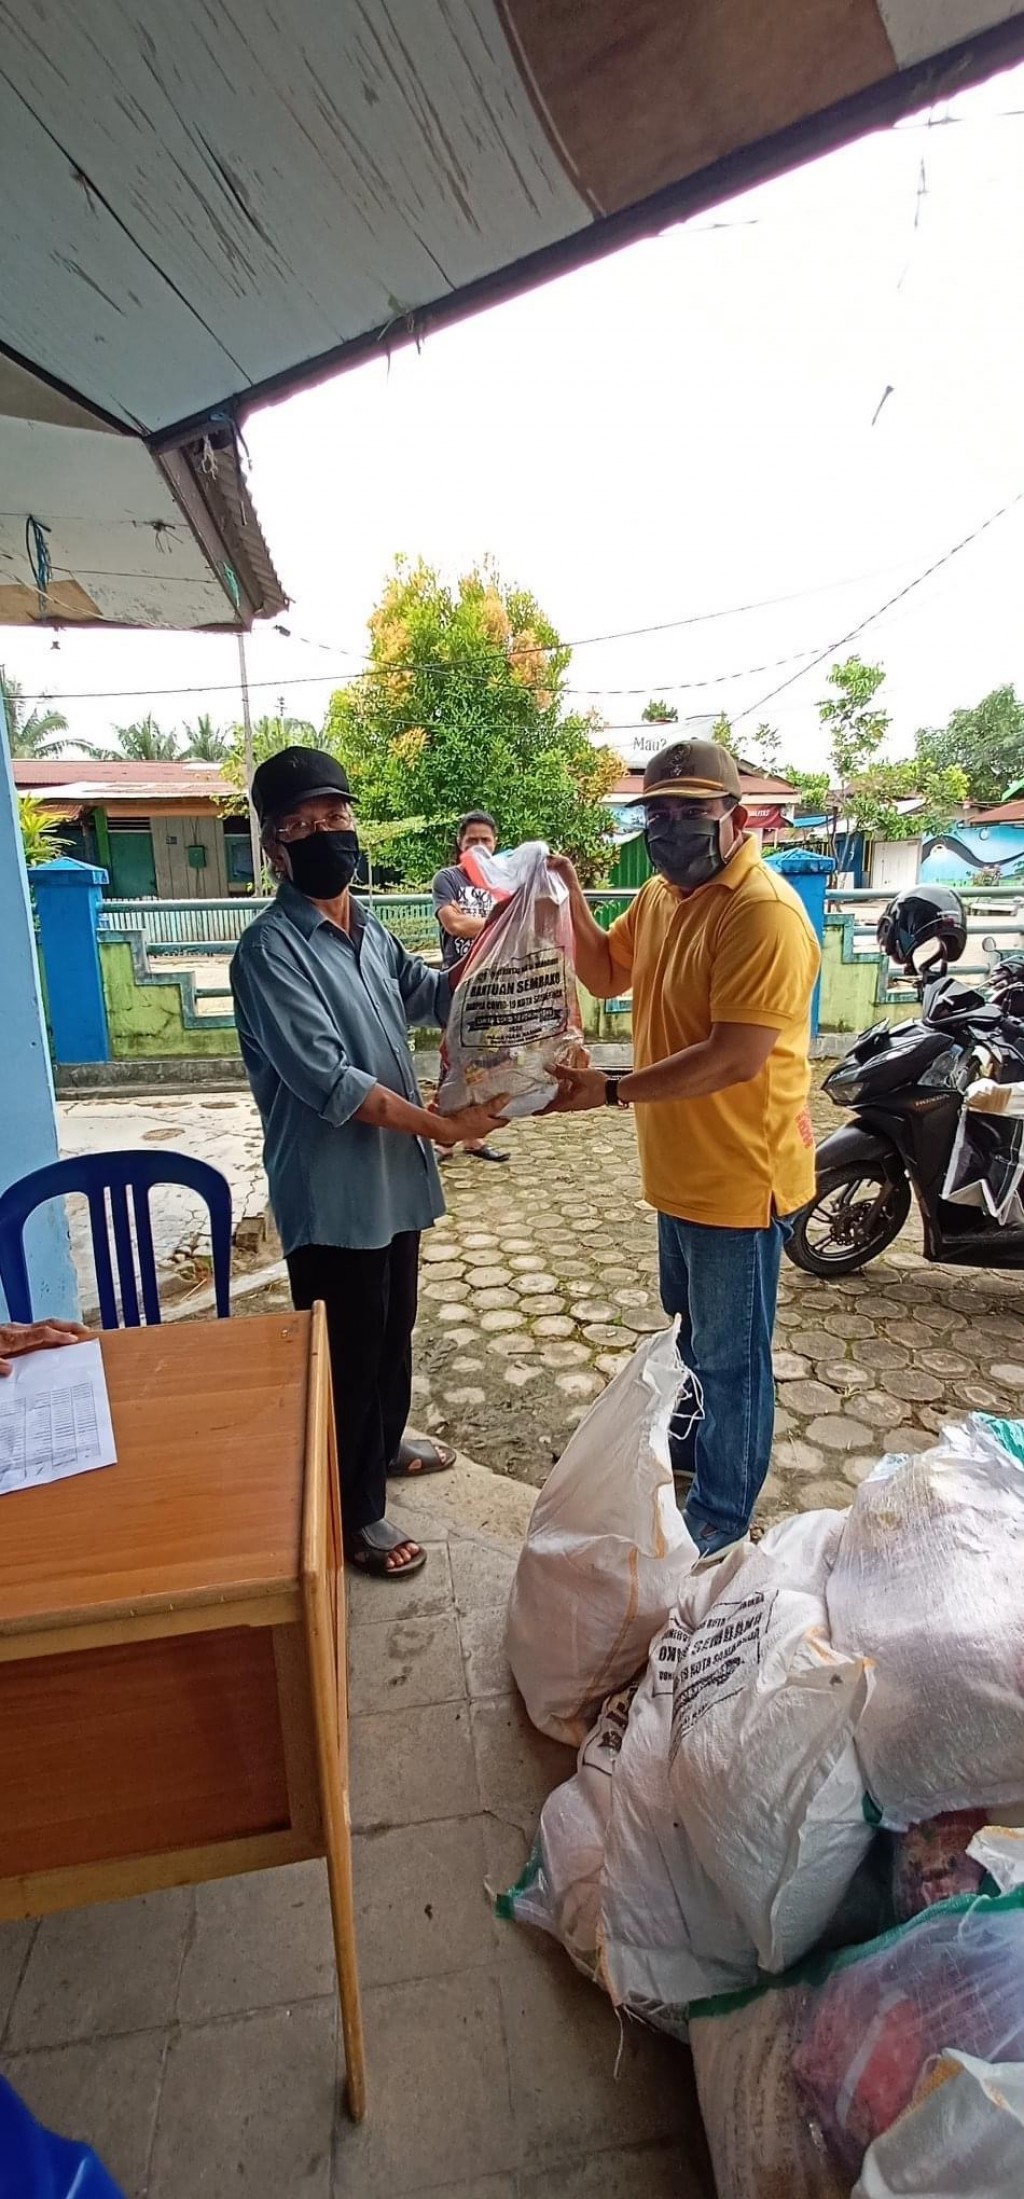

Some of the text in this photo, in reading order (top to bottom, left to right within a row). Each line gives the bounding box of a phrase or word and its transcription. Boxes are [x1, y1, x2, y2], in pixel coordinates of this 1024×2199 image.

[633, 736, 667, 751] Mau?
[470, 983, 515, 997] BANTUAN
[516, 972, 560, 992] SEMBAKO
